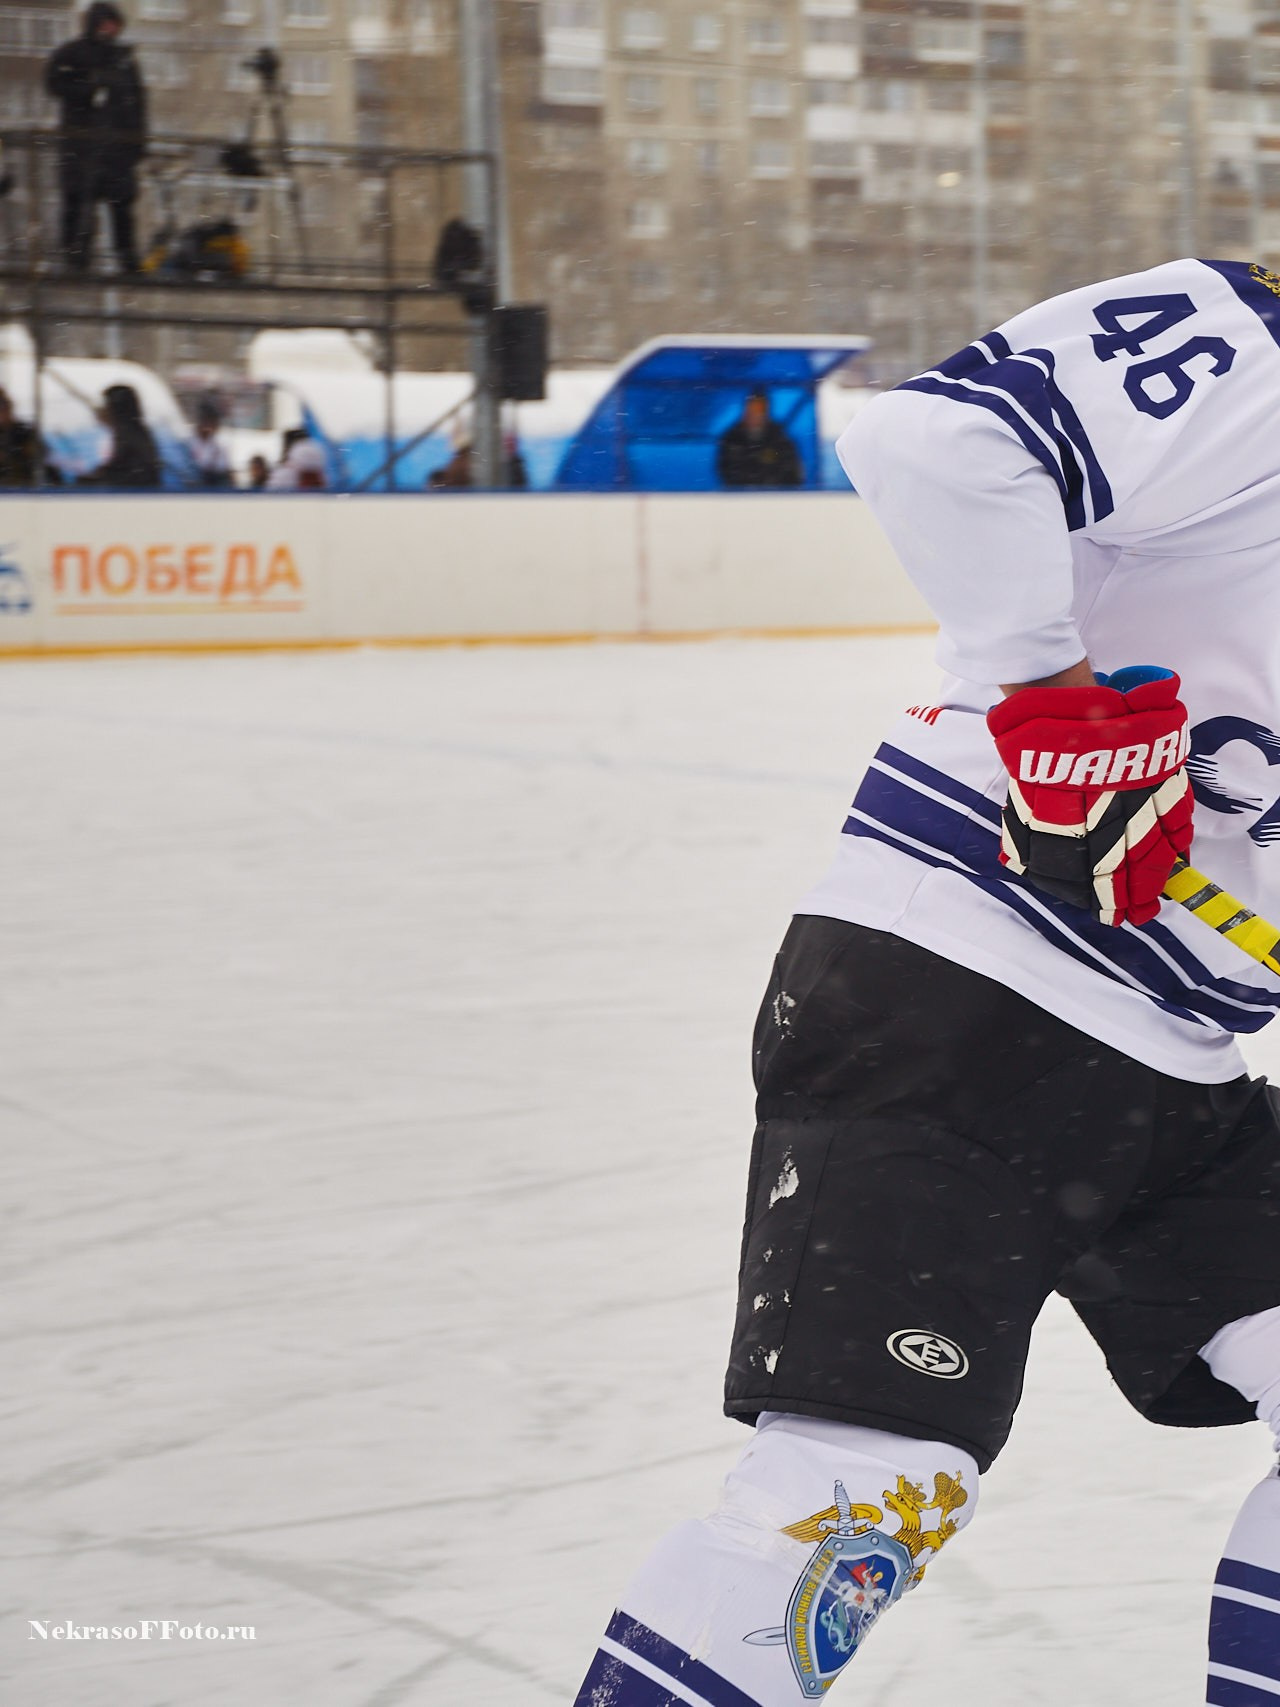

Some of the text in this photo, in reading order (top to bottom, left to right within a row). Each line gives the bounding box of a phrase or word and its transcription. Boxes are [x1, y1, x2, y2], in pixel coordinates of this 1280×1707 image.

[1089, 292, 1237, 421] 46
[52, 542, 304, 606] ПОБЕДА
[1019, 720, 1191, 787] WARRI
